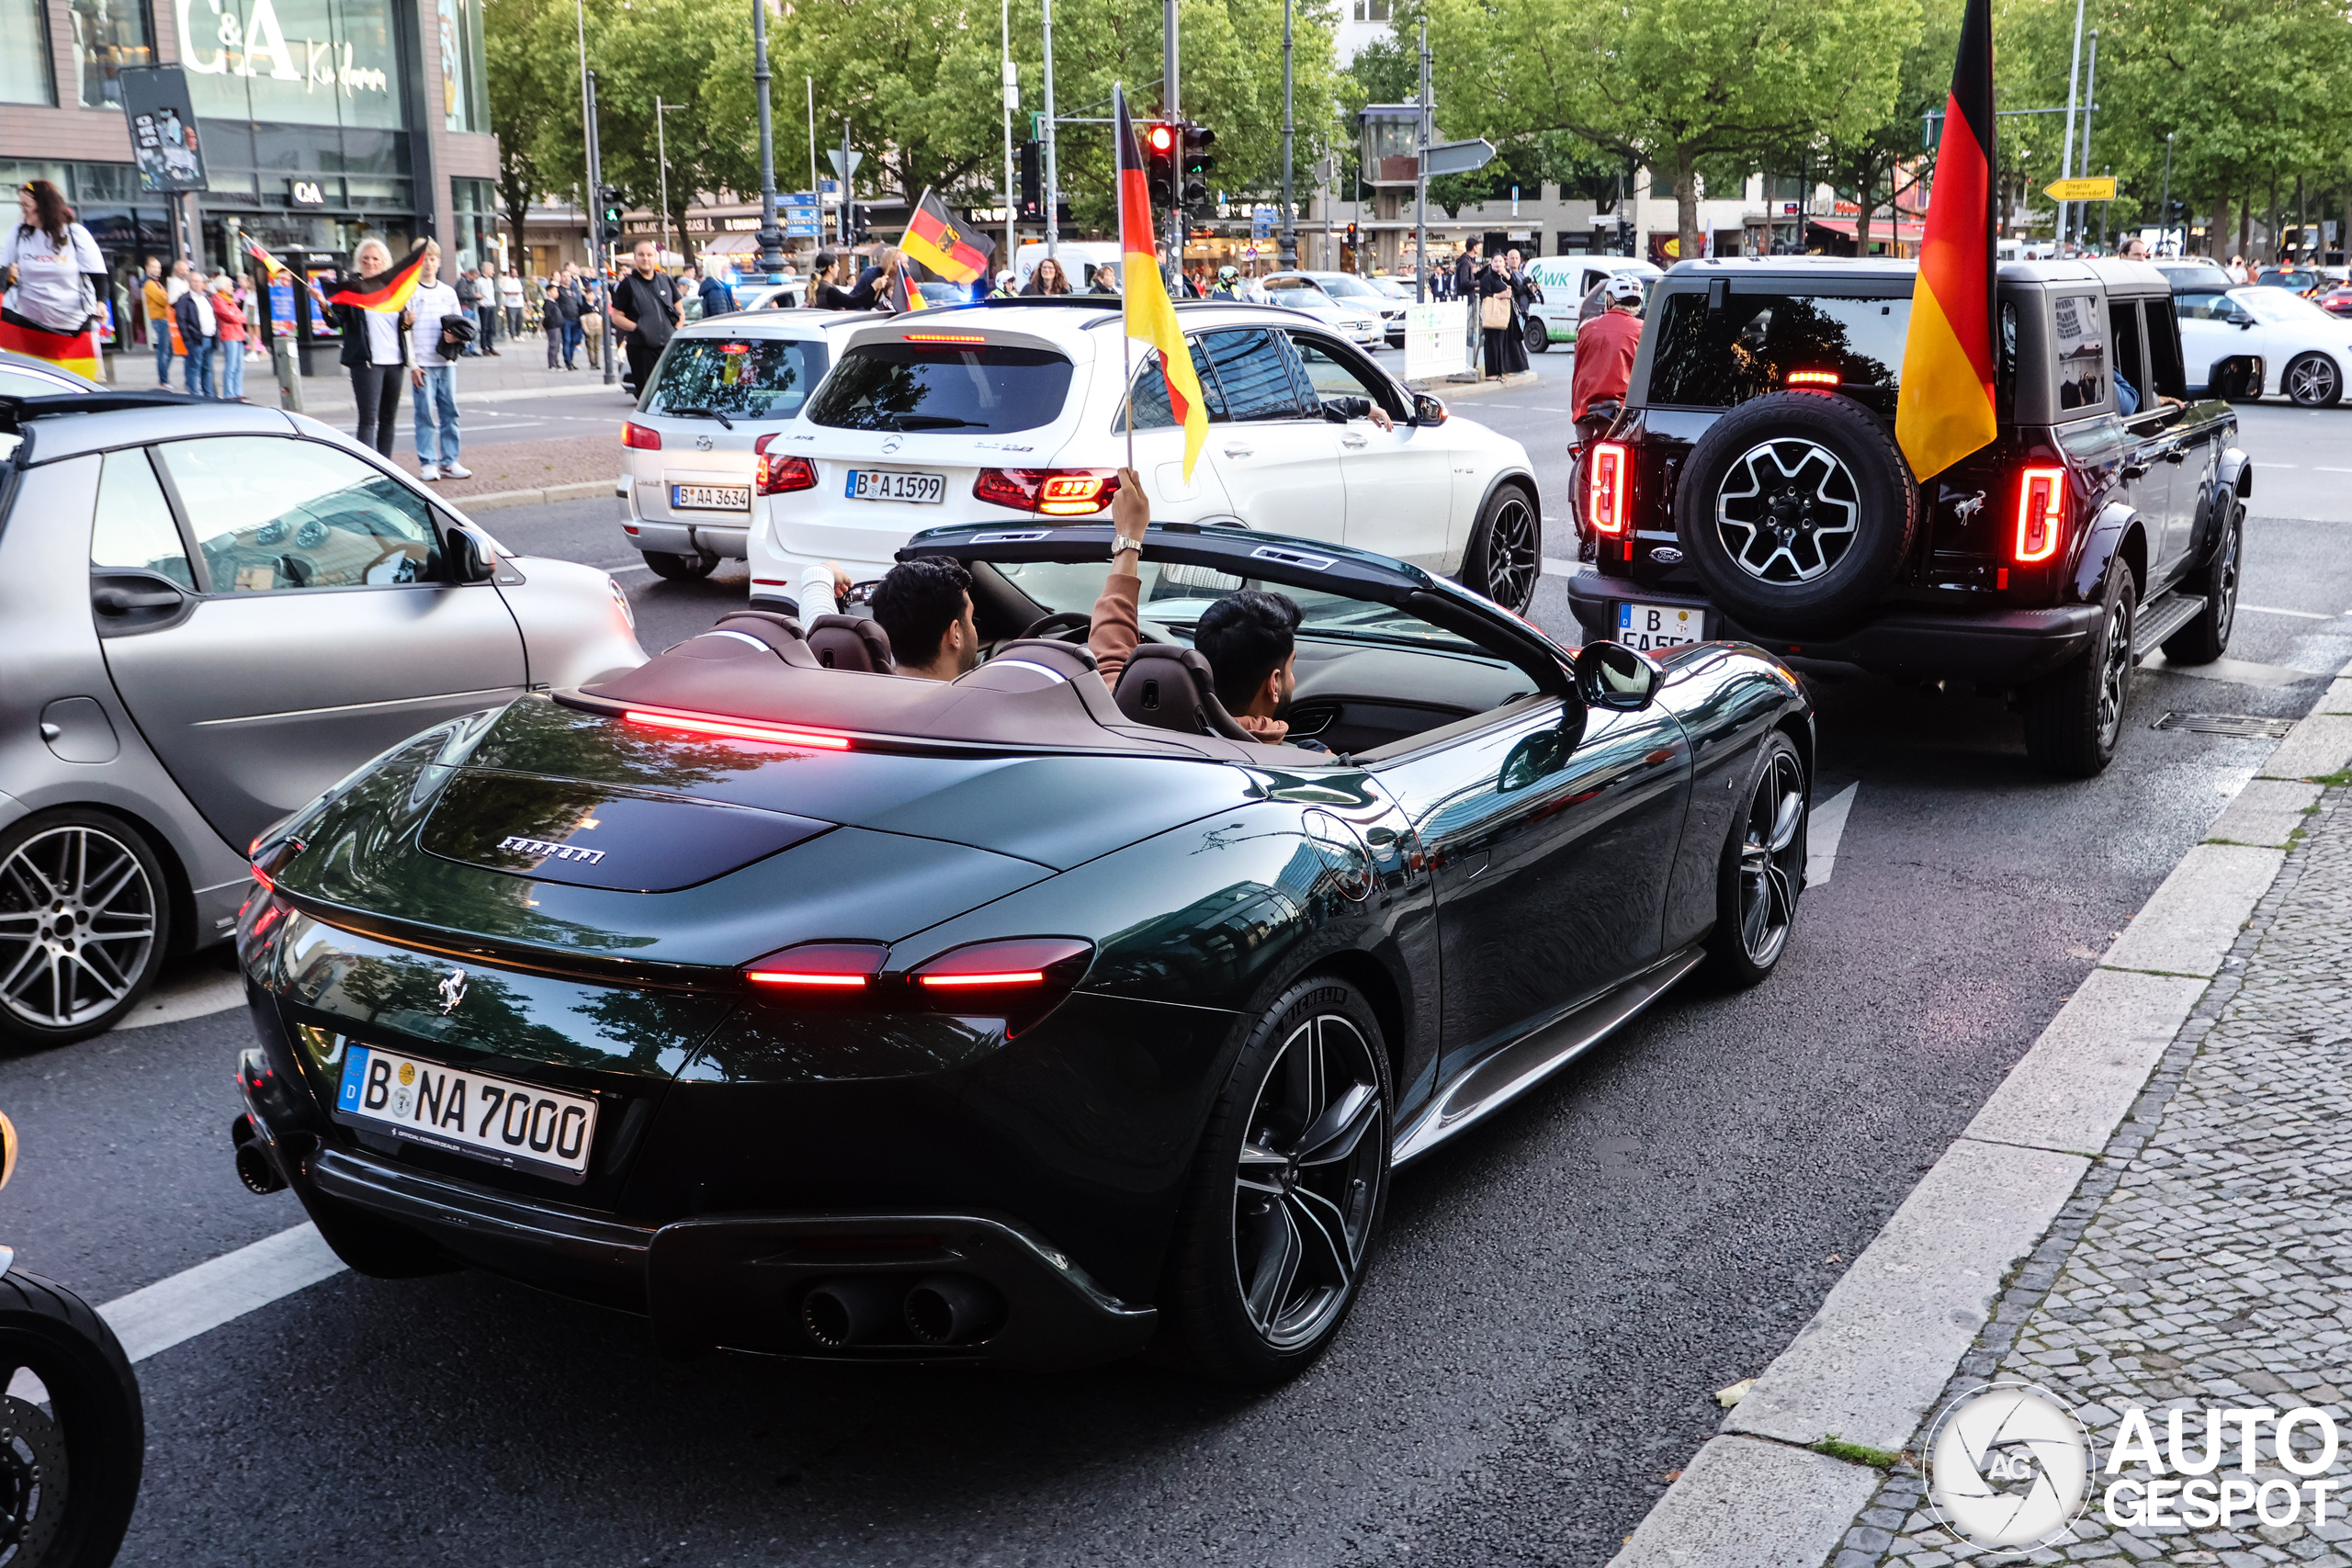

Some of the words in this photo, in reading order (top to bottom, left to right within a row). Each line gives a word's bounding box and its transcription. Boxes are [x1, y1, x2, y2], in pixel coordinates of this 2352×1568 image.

[175, 0, 300, 81] C&A
[681, 489, 689, 503] B
[696, 490, 712, 504] AA
[716, 491, 747, 505] 3634
[856, 474, 869, 494] B
[879, 479, 890, 497] A
[894, 478, 940, 500] 1599
[1657, 551, 1676, 560] Ford
[1647, 610, 1661, 631] B
[496, 836, 606, 865] Ferrari
[1283, 987, 1344, 1029] MICHELIN
[346, 1085, 356, 1100] D
[365, 1059, 391, 1110] B
[414, 1071, 466, 1133] NA
[479, 1086, 587, 1160] 7000
[398, 1131, 420, 1142] OFFICIAL
[420, 1136, 440, 1147] FERRARI
[440, 1142, 460, 1152] DEALER
